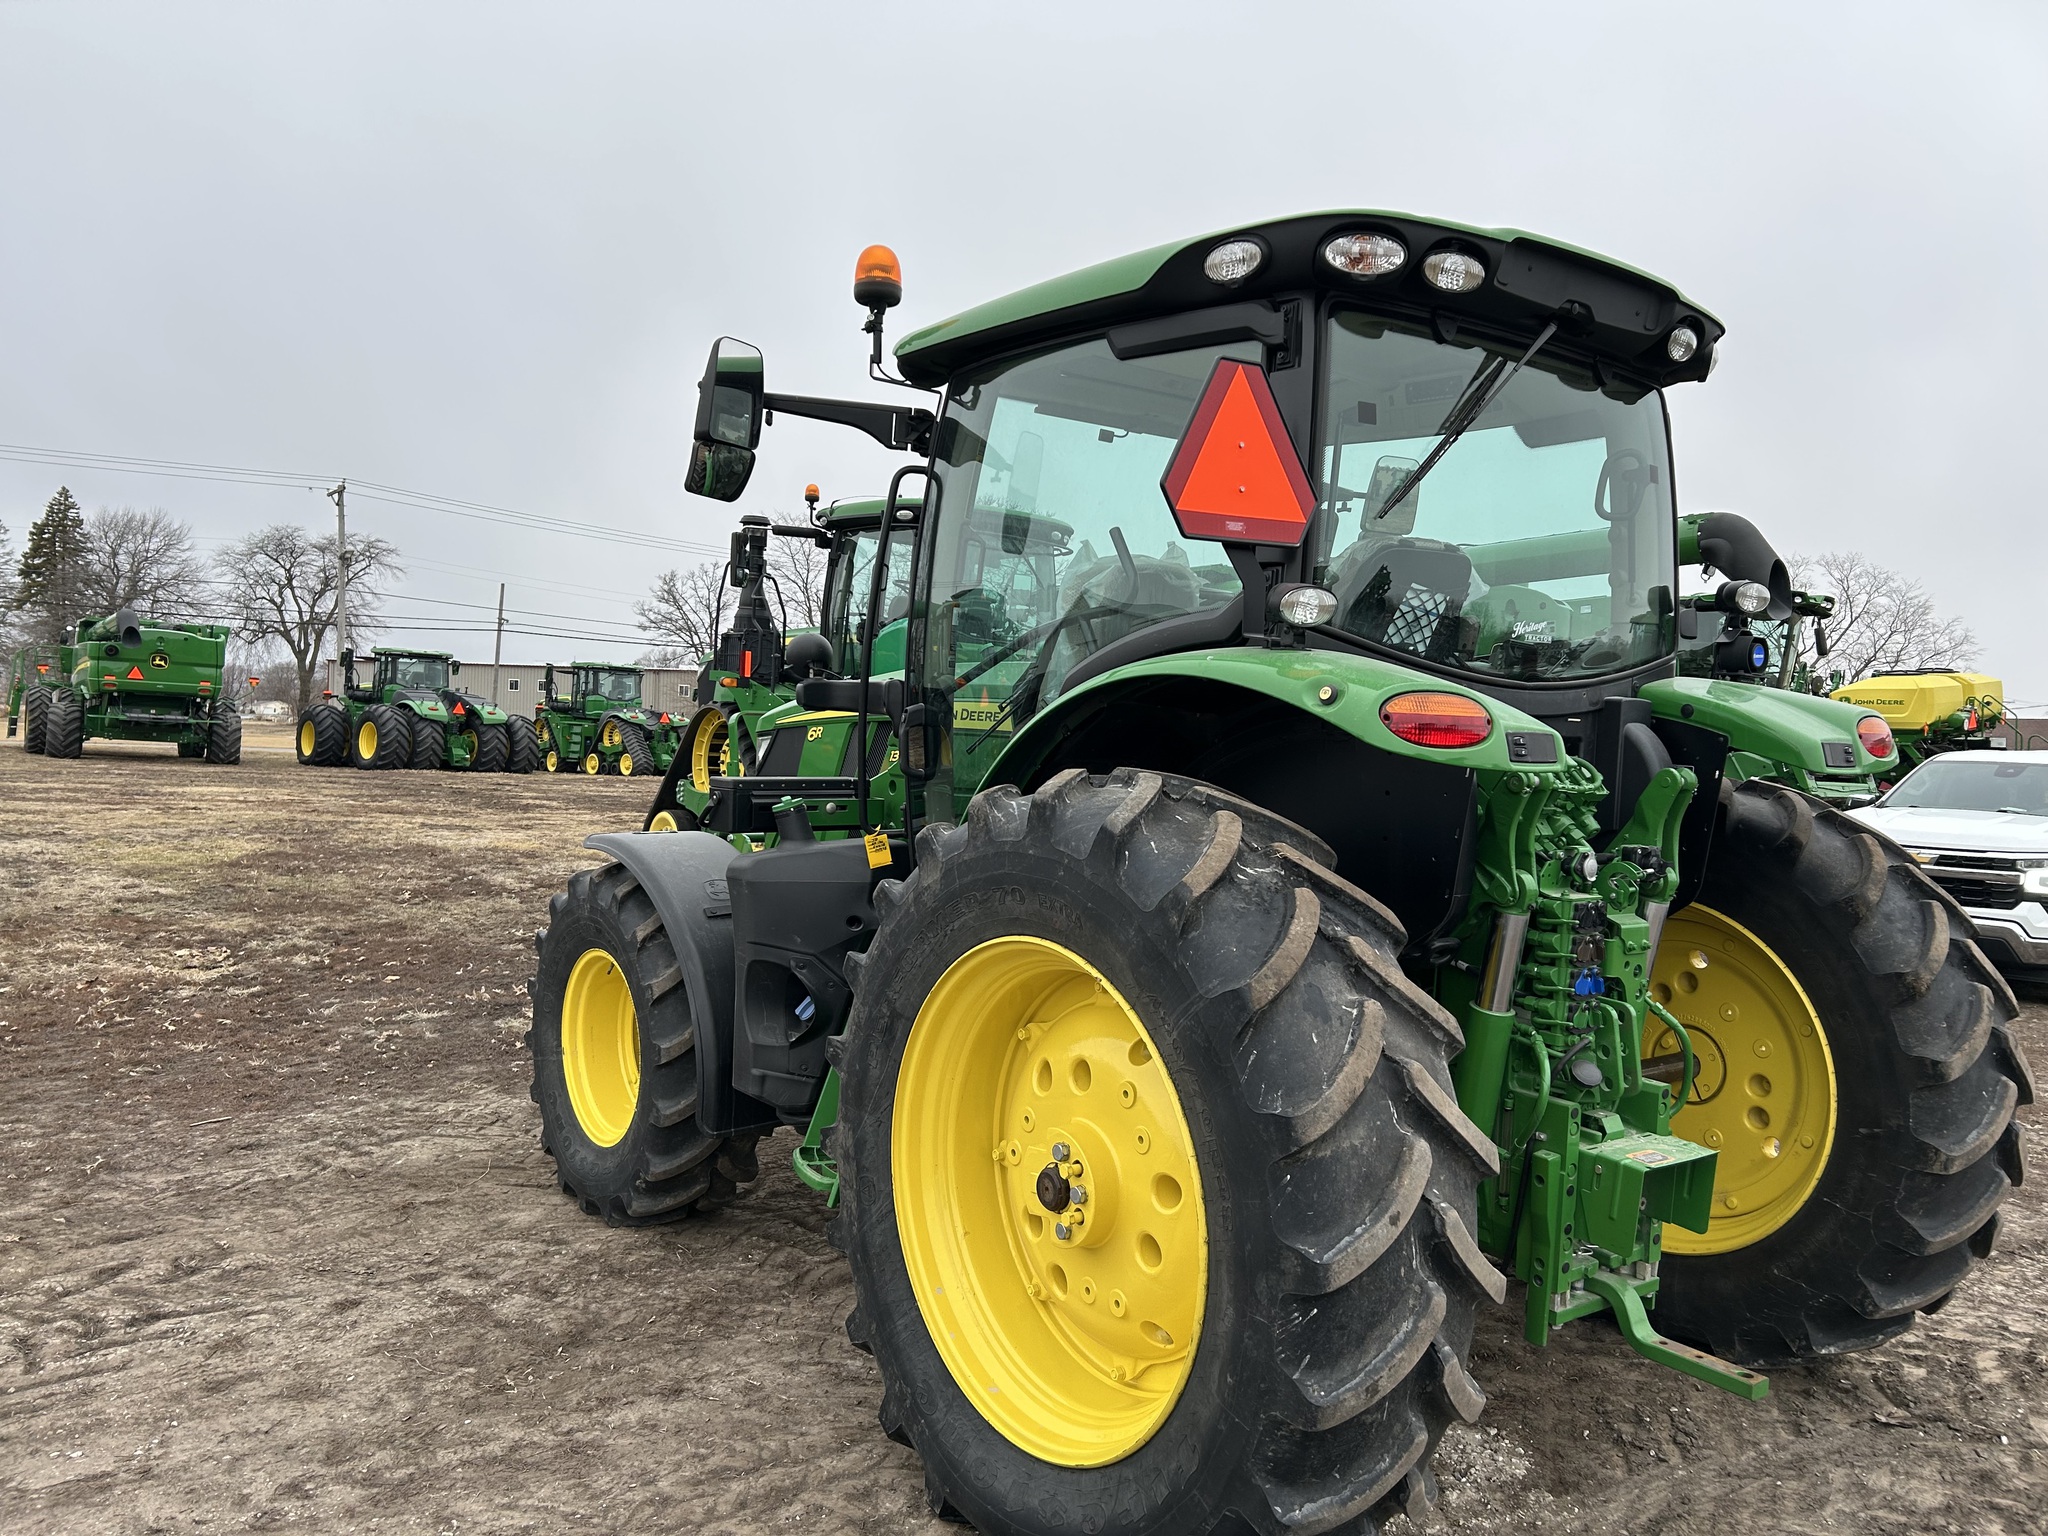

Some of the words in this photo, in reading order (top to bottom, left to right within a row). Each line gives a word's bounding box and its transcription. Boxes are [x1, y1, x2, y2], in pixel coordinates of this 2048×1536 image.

[1511, 620, 1547, 638] Heritage
[1525, 634, 1552, 643] TRACTOR
[960, 708, 1001, 723] DEERE
[807, 726, 824, 742] 6R
[889, 750, 900, 762] 13
[991, 885, 1026, 906] 70
[1036, 893, 1084, 931] EXTRA
